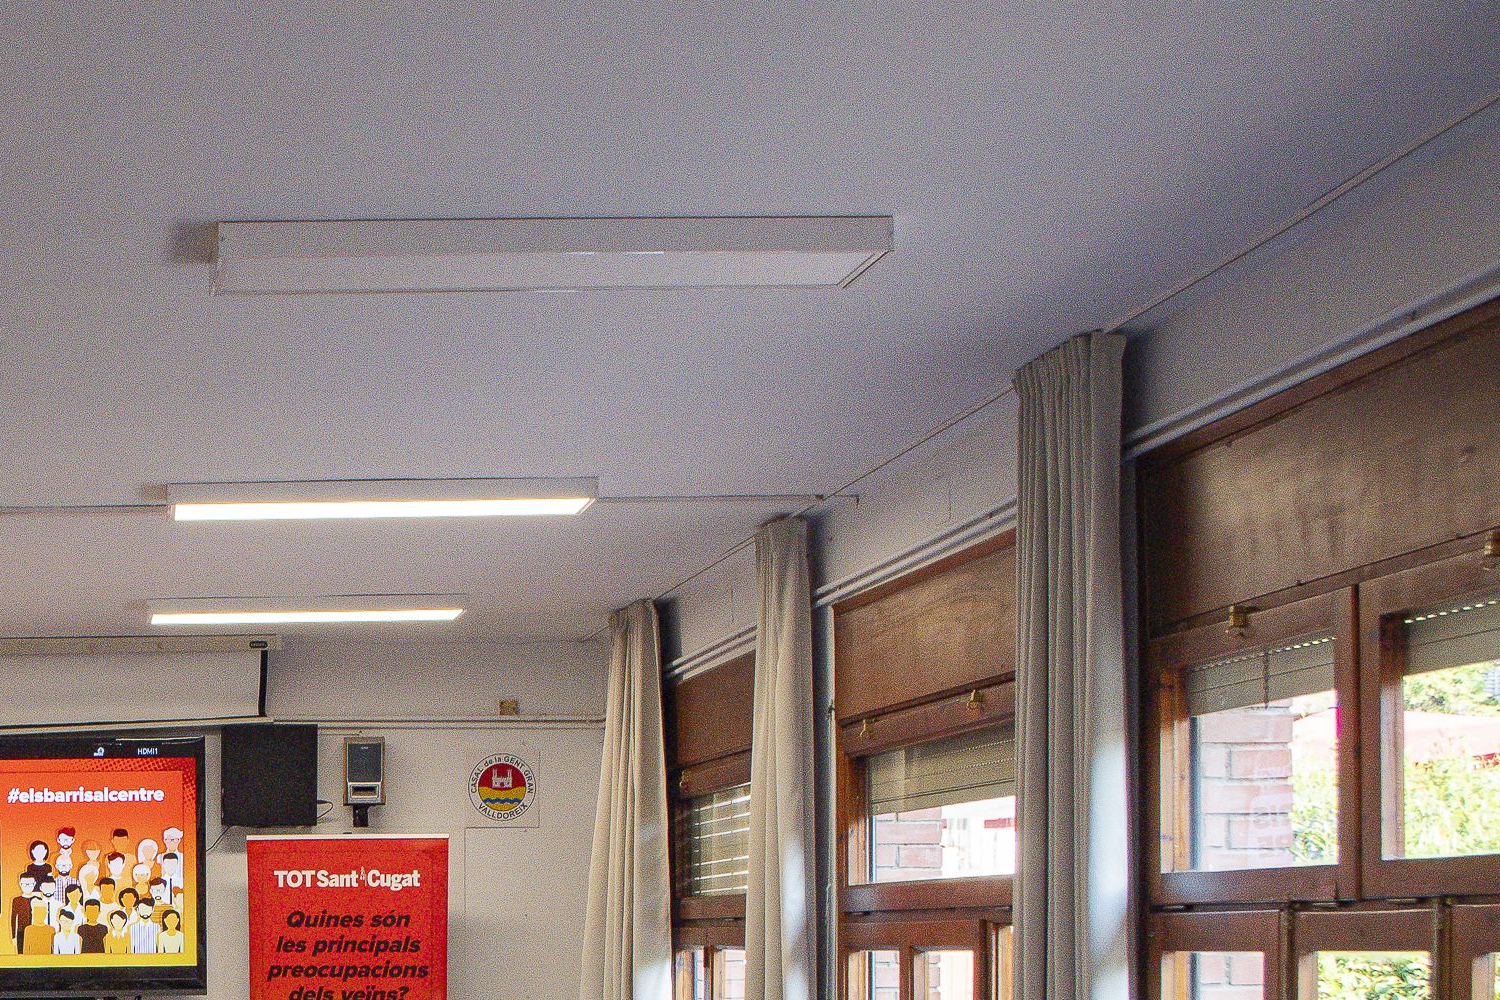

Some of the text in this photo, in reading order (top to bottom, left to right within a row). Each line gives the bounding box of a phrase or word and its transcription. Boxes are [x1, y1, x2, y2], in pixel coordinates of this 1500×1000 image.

[137, 747, 158, 756] HDMI1
[471, 768, 485, 794] CASAL
[503, 755, 526, 770] GENT
[523, 769, 534, 794] GRAN
[7, 785, 165, 804] #elsbarrisalcentre
[477, 802, 528, 820] VALLDOREIX
[367, 869, 421, 891] Cugat
[286, 909, 411, 929] Quines són
[275, 935, 421, 956] les principals
[267, 959, 429, 982] preocupacions
